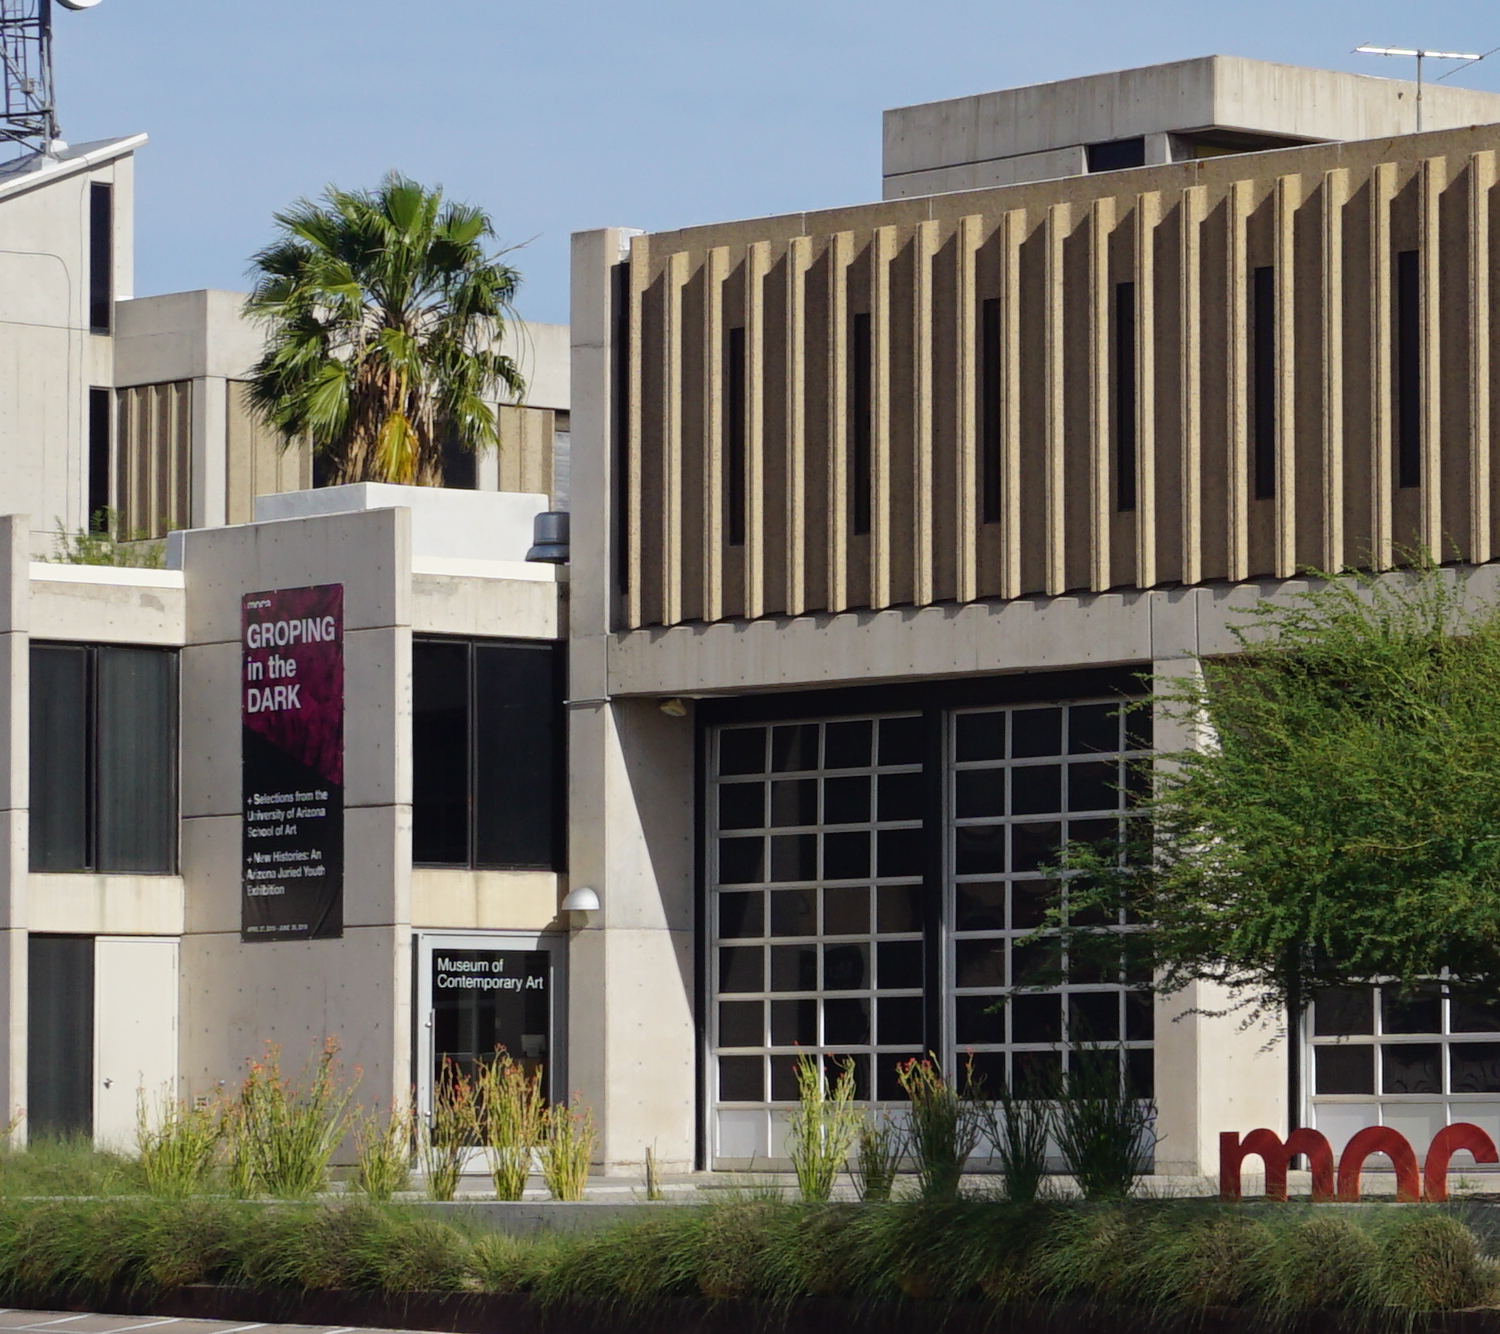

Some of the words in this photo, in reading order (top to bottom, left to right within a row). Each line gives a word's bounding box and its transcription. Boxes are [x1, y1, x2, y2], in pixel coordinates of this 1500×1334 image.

[247, 616, 335, 649] GROPING
[247, 656, 263, 681] in
[268, 653, 296, 679] the
[247, 684, 301, 713] DARK
[254, 792, 294, 805] Selections
[295, 791, 314, 802] from
[315, 789, 328, 800] the
[247, 808, 285, 822] University
[286, 807, 295, 819] of
[296, 806, 326, 818] Arizona
[247, 825, 274, 838] School
[275, 824, 283, 836] of
[285, 823, 298, 835] Art
[254, 852, 272, 863] New
[273, 849, 309, 862] Histories:
[311, 848, 322, 860] An
[246, 868, 276, 880] Arizona
[303, 865, 326, 877] Youth
[246, 884, 285, 896] Exhibition
[437, 957, 489, 972] Museum
[491, 958, 504, 973] of
[437, 973, 523, 992] Contemporary
[525, 975, 544, 990] Art
